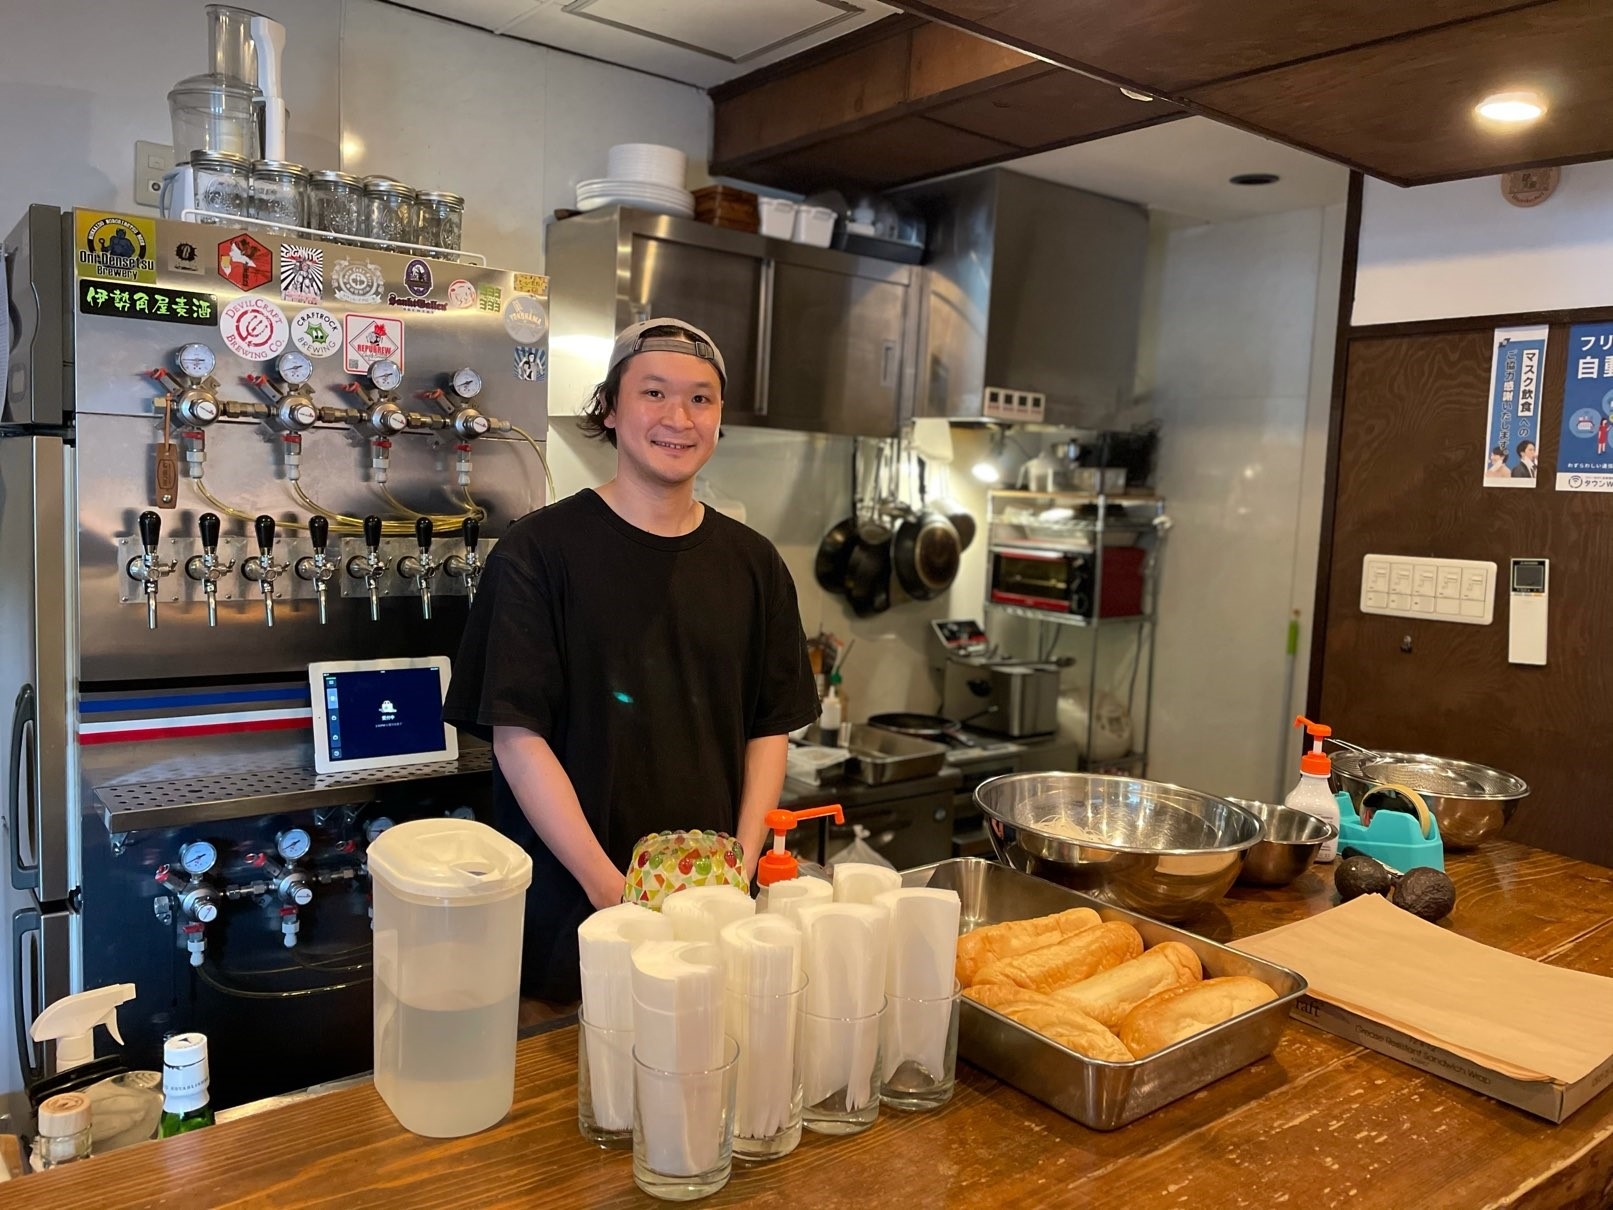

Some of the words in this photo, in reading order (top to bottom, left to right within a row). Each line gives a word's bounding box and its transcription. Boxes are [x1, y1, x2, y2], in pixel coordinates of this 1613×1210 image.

[97, 265, 138, 280] Brewery
[297, 312, 338, 332] CRAFTROCK
[297, 337, 336, 354] BREWING
[357, 344, 392, 355] REPUBREW
[1295, 997, 1320, 1017] raft
